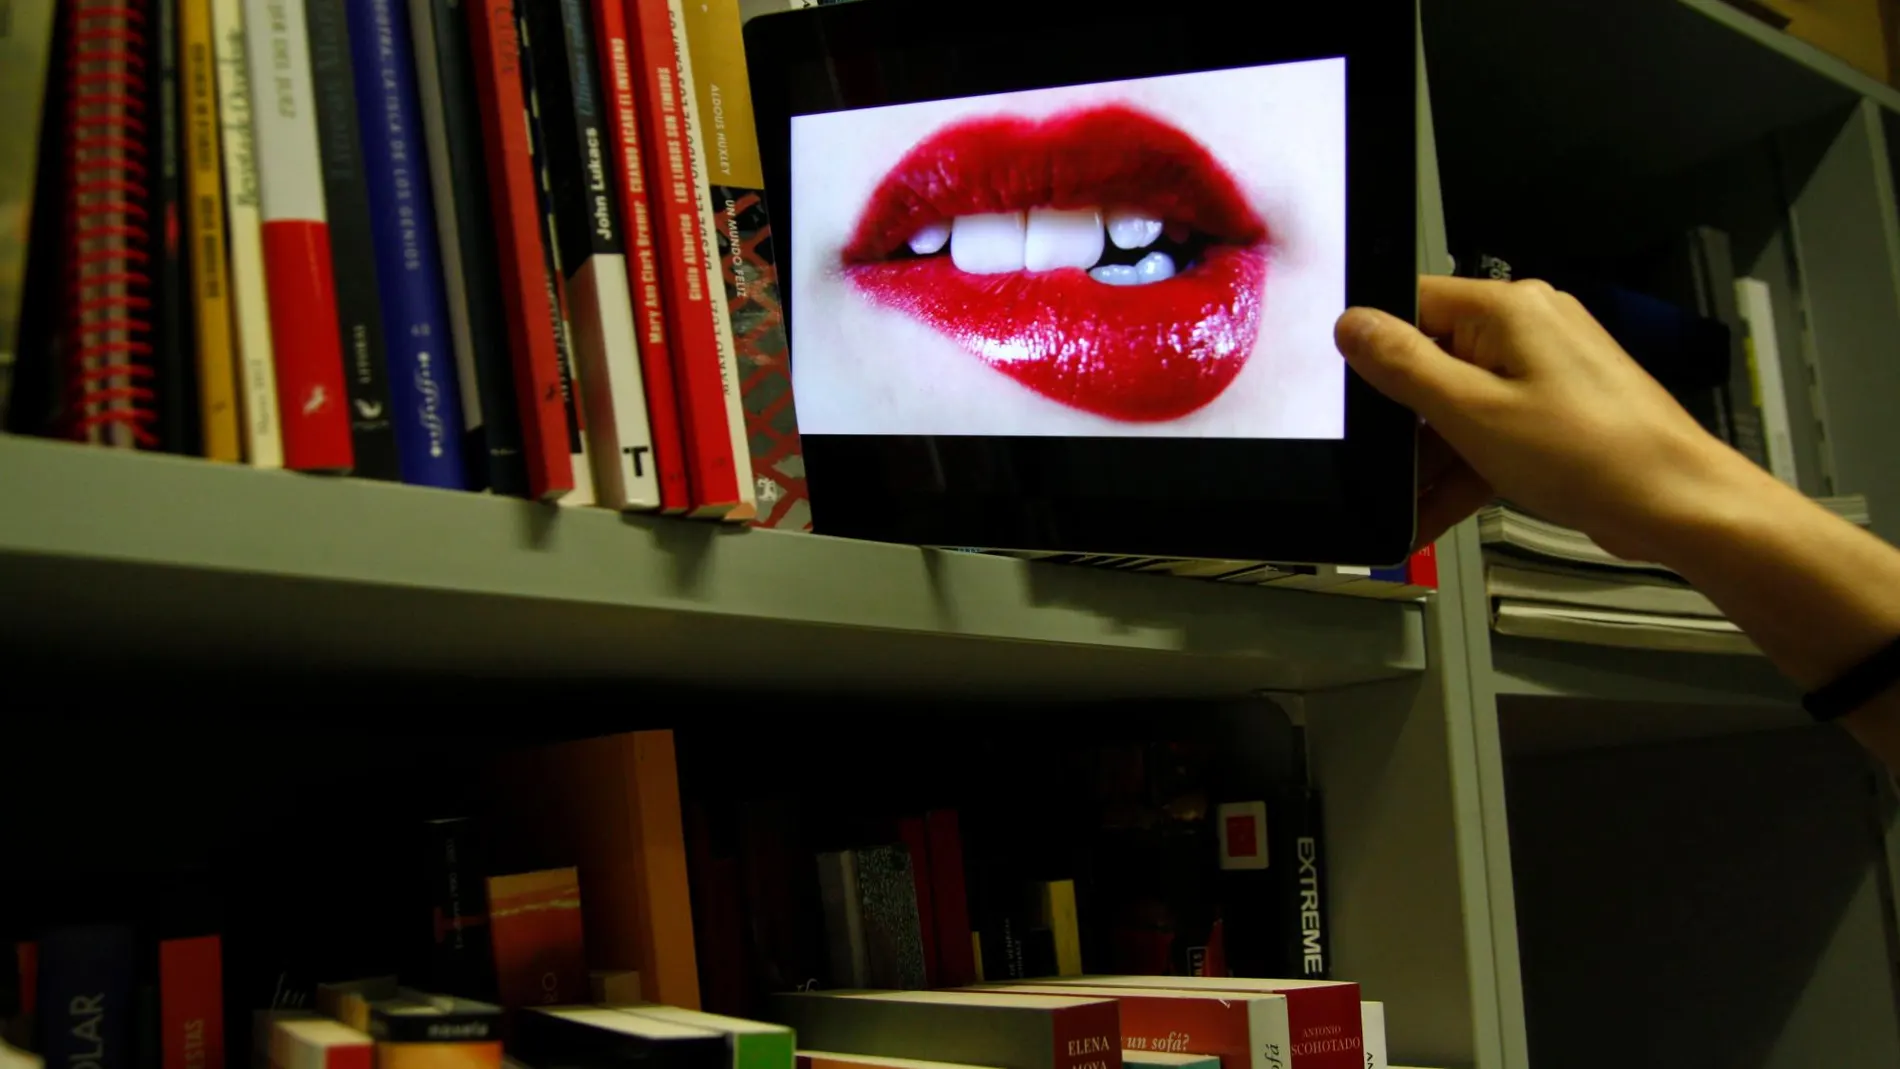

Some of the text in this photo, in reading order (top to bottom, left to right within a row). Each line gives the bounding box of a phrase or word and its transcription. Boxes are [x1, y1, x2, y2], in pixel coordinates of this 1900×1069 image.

[663, 115, 679, 138] SON
[710, 83, 731, 176] ALDOUS HUXLEY
[389, 139, 407, 162] DE
[584, 128, 606, 191] Lukacs
[668, 140, 686, 180] LIBROS
[393, 167, 411, 201] LOS
[610, 37, 664, 344] Mary Ann Clark Bremer CUANDO ACABE EL INVIERNO
[673, 181, 689, 204] LOS
[595, 195, 612, 241] John
[397, 204, 422, 271] GENIOS
[724, 198, 748, 298] UN MUNDO FELIZ
[623, 446, 648, 477] T
[1296, 836, 1323, 975] EXTREME
[1068, 1036, 1110, 1057] ELENA
[1127, 1031, 1190, 1053] un sofá?
[1303, 1025, 1342, 1039] ANTONIO
